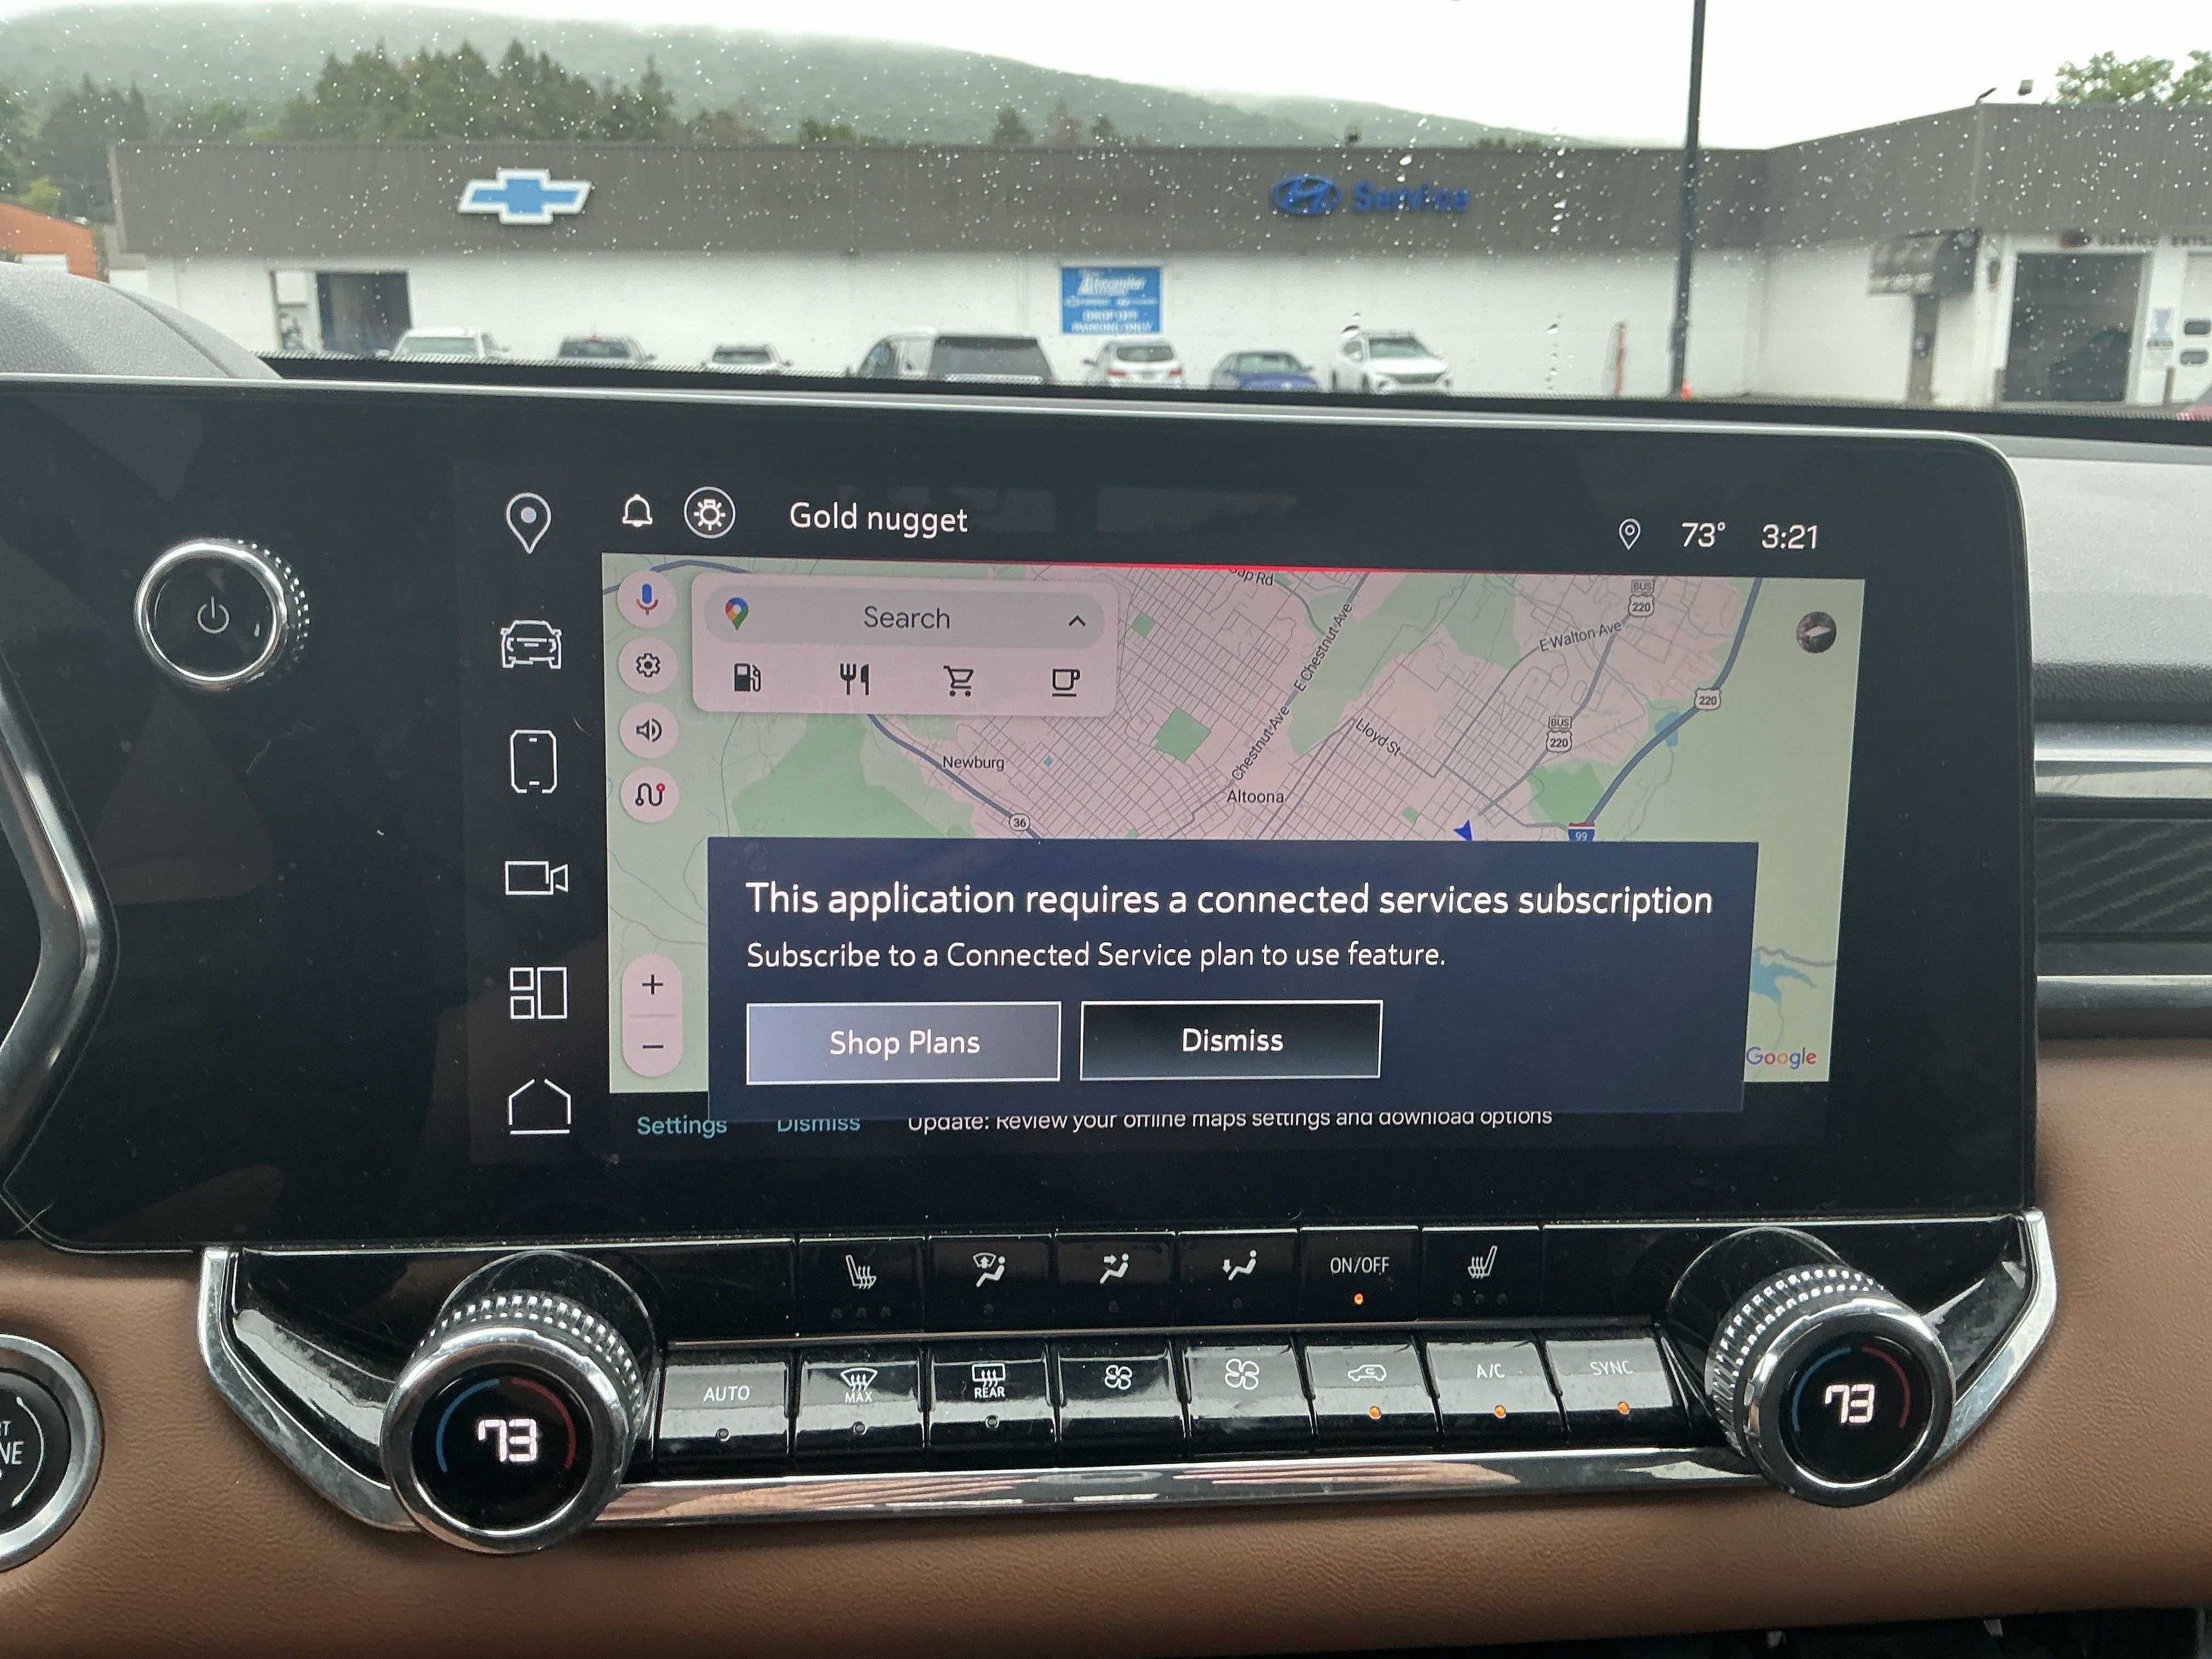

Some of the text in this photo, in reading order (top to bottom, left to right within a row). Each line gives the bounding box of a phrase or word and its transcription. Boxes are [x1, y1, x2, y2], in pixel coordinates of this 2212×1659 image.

[1352, 180, 1470, 211] Service
[790, 501, 968, 539] Gold nugget
[1681, 522, 1725, 548] 73°
[1762, 524, 1818, 549] 3:21
[1256, 572, 1273, 586] Rd
[1633, 582, 1652, 591] BUS
[864, 605, 950, 629] Search
[1632, 602, 1651, 612] 220
[1294, 604, 1352, 692] E Chestnut Ave
[1539, 622, 1621, 652] E Walton Ave
[1699, 696, 1717, 705] 220
[1551, 718, 1570, 726] BUS
[1232, 706, 1289, 780] Chestnut Ave
[1356, 718, 1401, 757] Lloyd St
[1550, 738, 1568, 747] 220
[943, 755, 1005, 772] Newburg
[1227, 789, 1284, 803] Altoona
[1013, 817, 1026, 827] 36
[1575, 831, 1587, 842] 99
[745, 881, 1712, 922] This application requires a connected services subscription
[747, 940, 1447, 973] Subscribe to a Connected Service plan to use feature.
[830, 1029, 981, 1061] Shop Plans
[1182, 1028, 1284, 1052] Dismiss
[1746, 1046, 1817, 1069] Google
[637, 1114, 727, 1139] Settings
[1330, 1256, 1390, 1276] ON/OFF
[1476, 1363, 1505, 1379] A/C
[1592, 1360, 1633, 1376] SYNC
[703, 1385, 751, 1402] AUTO
[845, 1391, 873, 1404] MAX
[974, 1386, 1005, 1399] REAR
[1824, 1383, 1875, 1424] 73
[476, 1418, 539, 1464] 73
